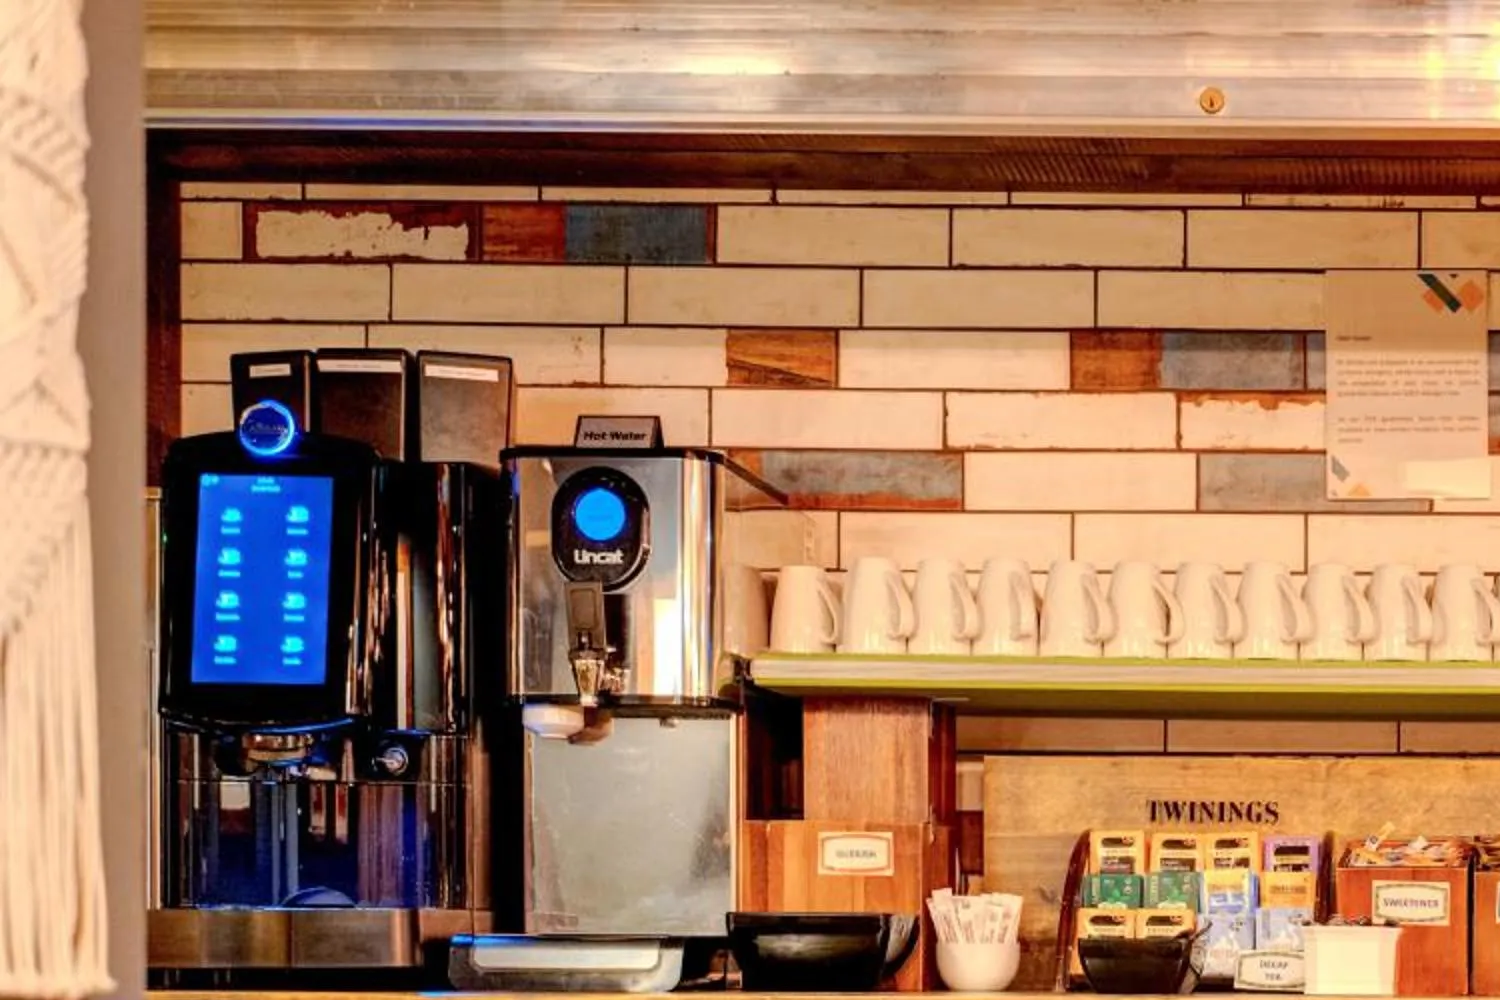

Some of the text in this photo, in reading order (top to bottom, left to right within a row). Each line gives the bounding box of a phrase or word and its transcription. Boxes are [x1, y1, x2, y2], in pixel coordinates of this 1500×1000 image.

[583, 431, 647, 441] Hot Water
[1146, 799, 1280, 824] TWININGS
